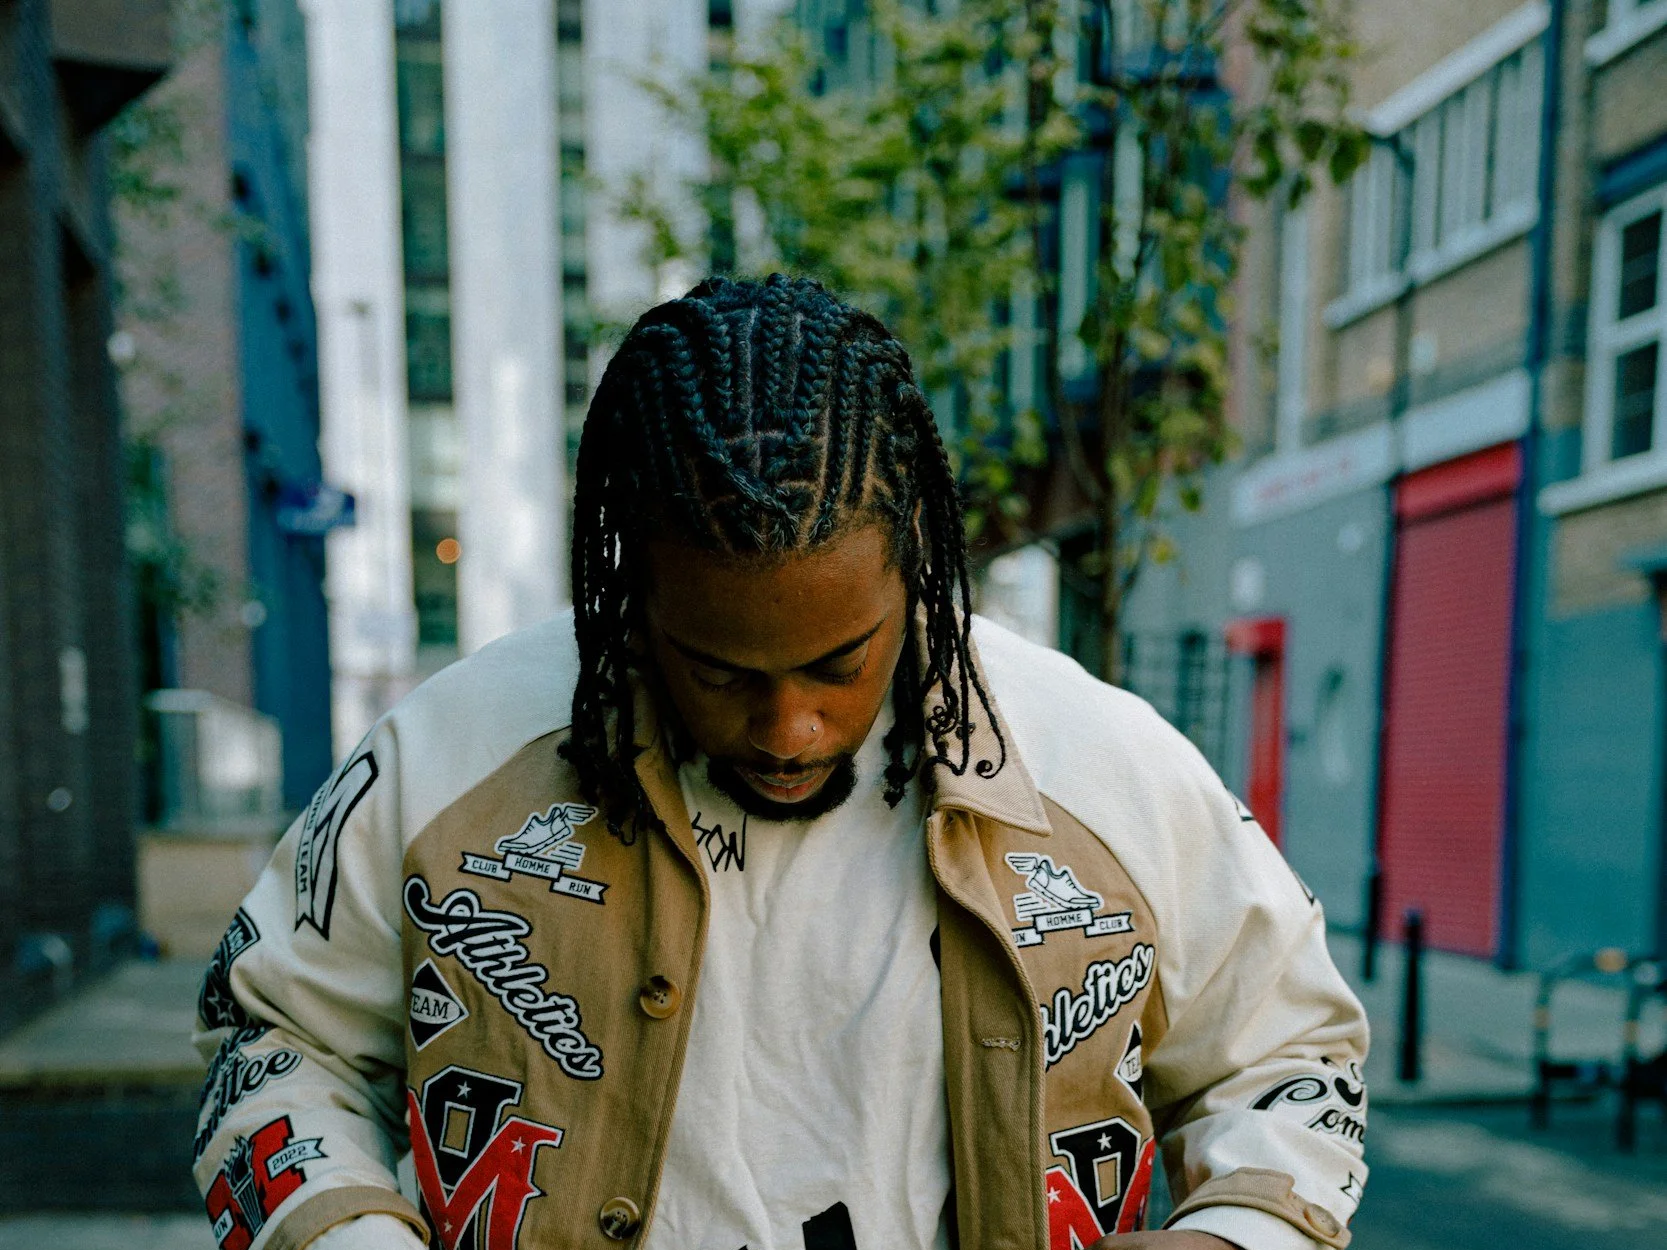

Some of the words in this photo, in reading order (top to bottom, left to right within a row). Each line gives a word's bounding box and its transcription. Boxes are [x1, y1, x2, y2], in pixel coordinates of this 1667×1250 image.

[471, 859, 498, 875] CLUB
[514, 857, 551, 875] HOMME
[568, 881, 592, 896] RUN
[1046, 913, 1083, 928] HOMME
[1099, 918, 1124, 931] CLUB
[403, 874, 605, 1081] Athletics
[411, 992, 450, 1020] EAM
[271, 1144, 308, 1171] 2022
